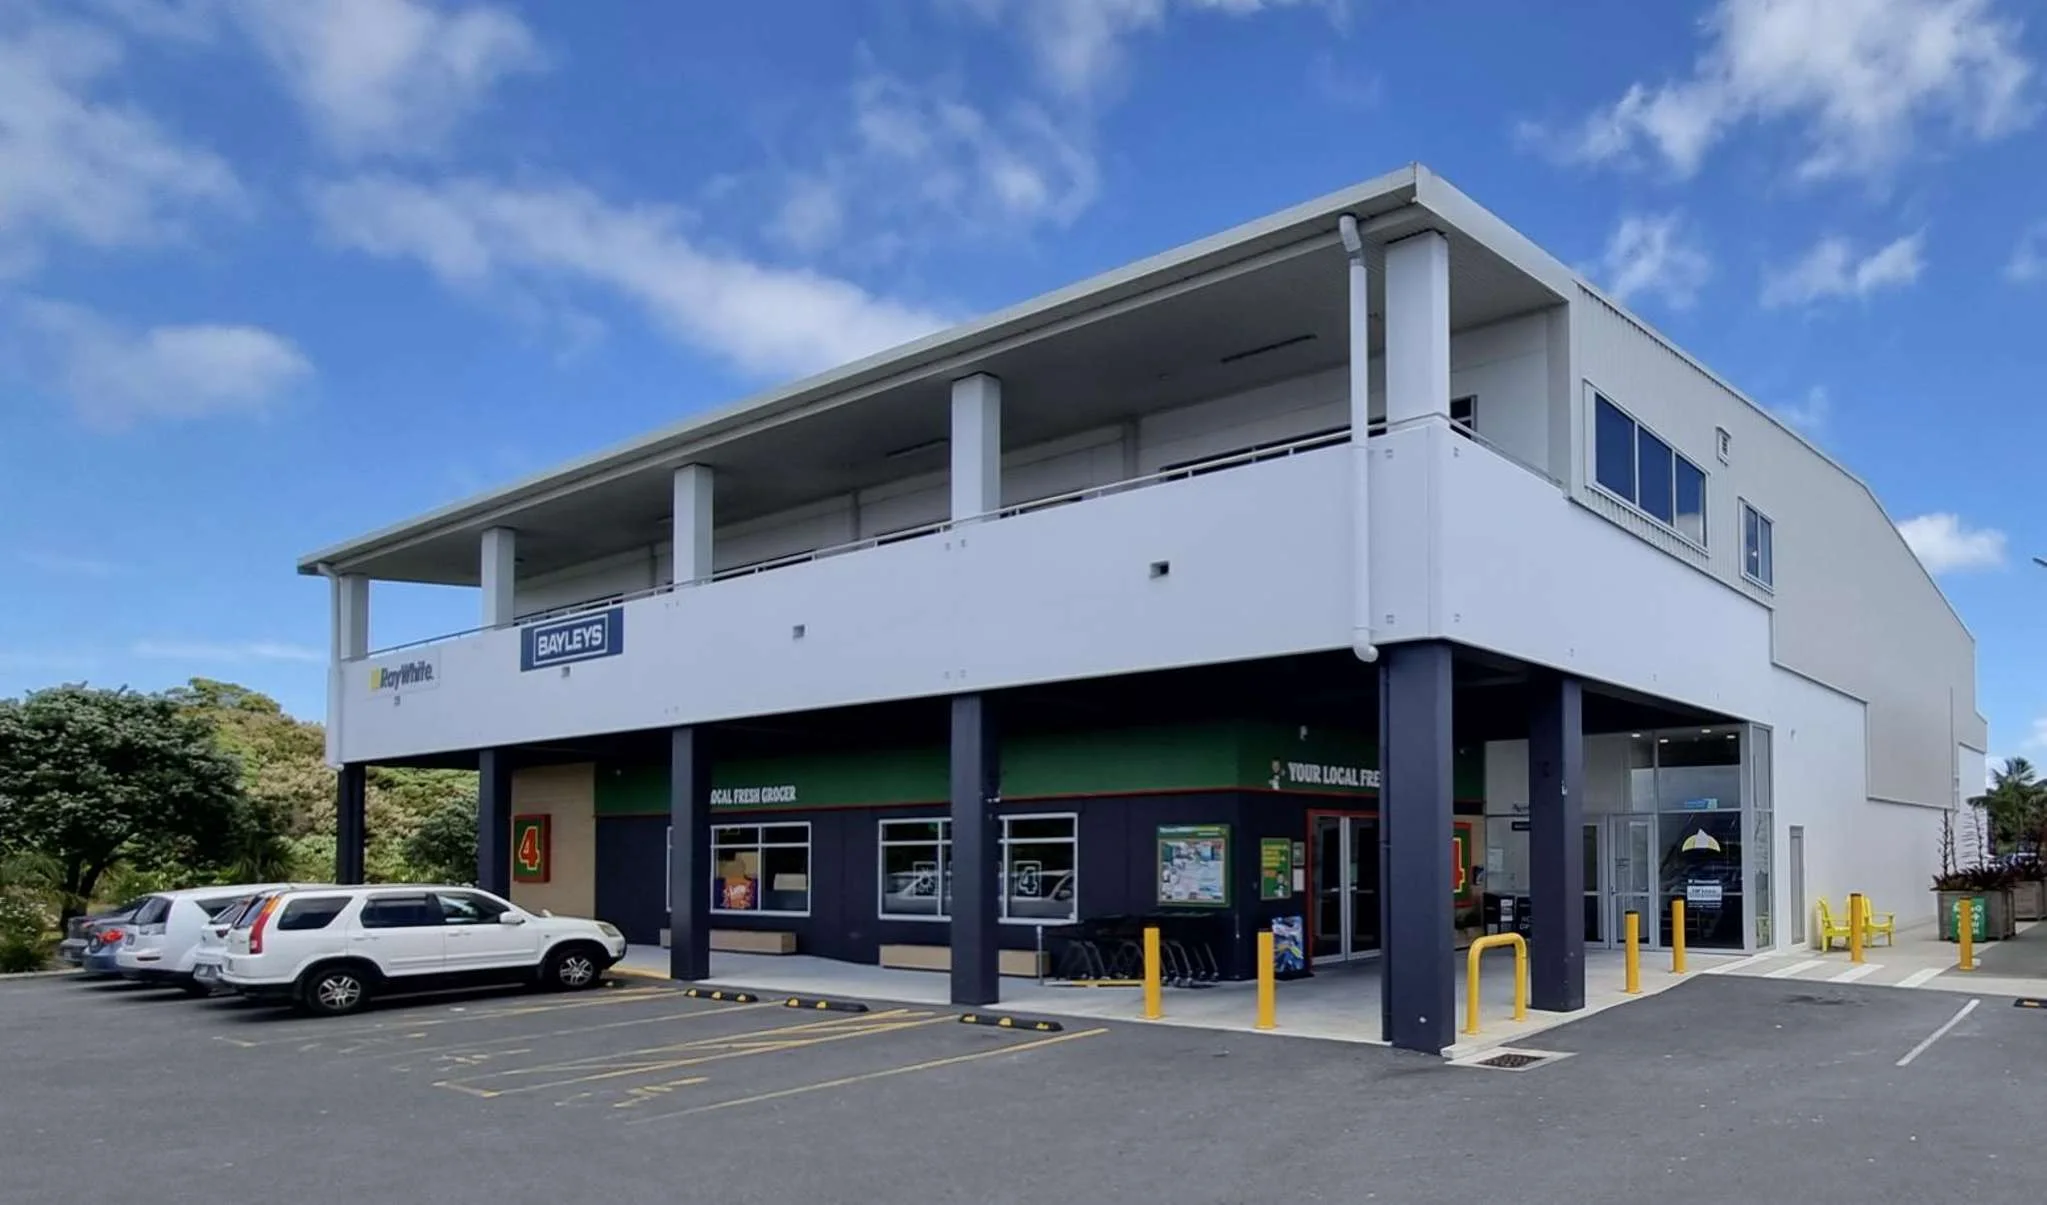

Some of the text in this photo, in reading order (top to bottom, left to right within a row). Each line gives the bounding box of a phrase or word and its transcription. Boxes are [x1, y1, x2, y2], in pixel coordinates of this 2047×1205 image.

[538, 624, 603, 656] BAYLEYS
[1287, 761, 1381, 788] YOUR LOCAL FRE
[710, 785, 797, 805] OCAL FRESH GROCER
[518, 825, 541, 871] 4
